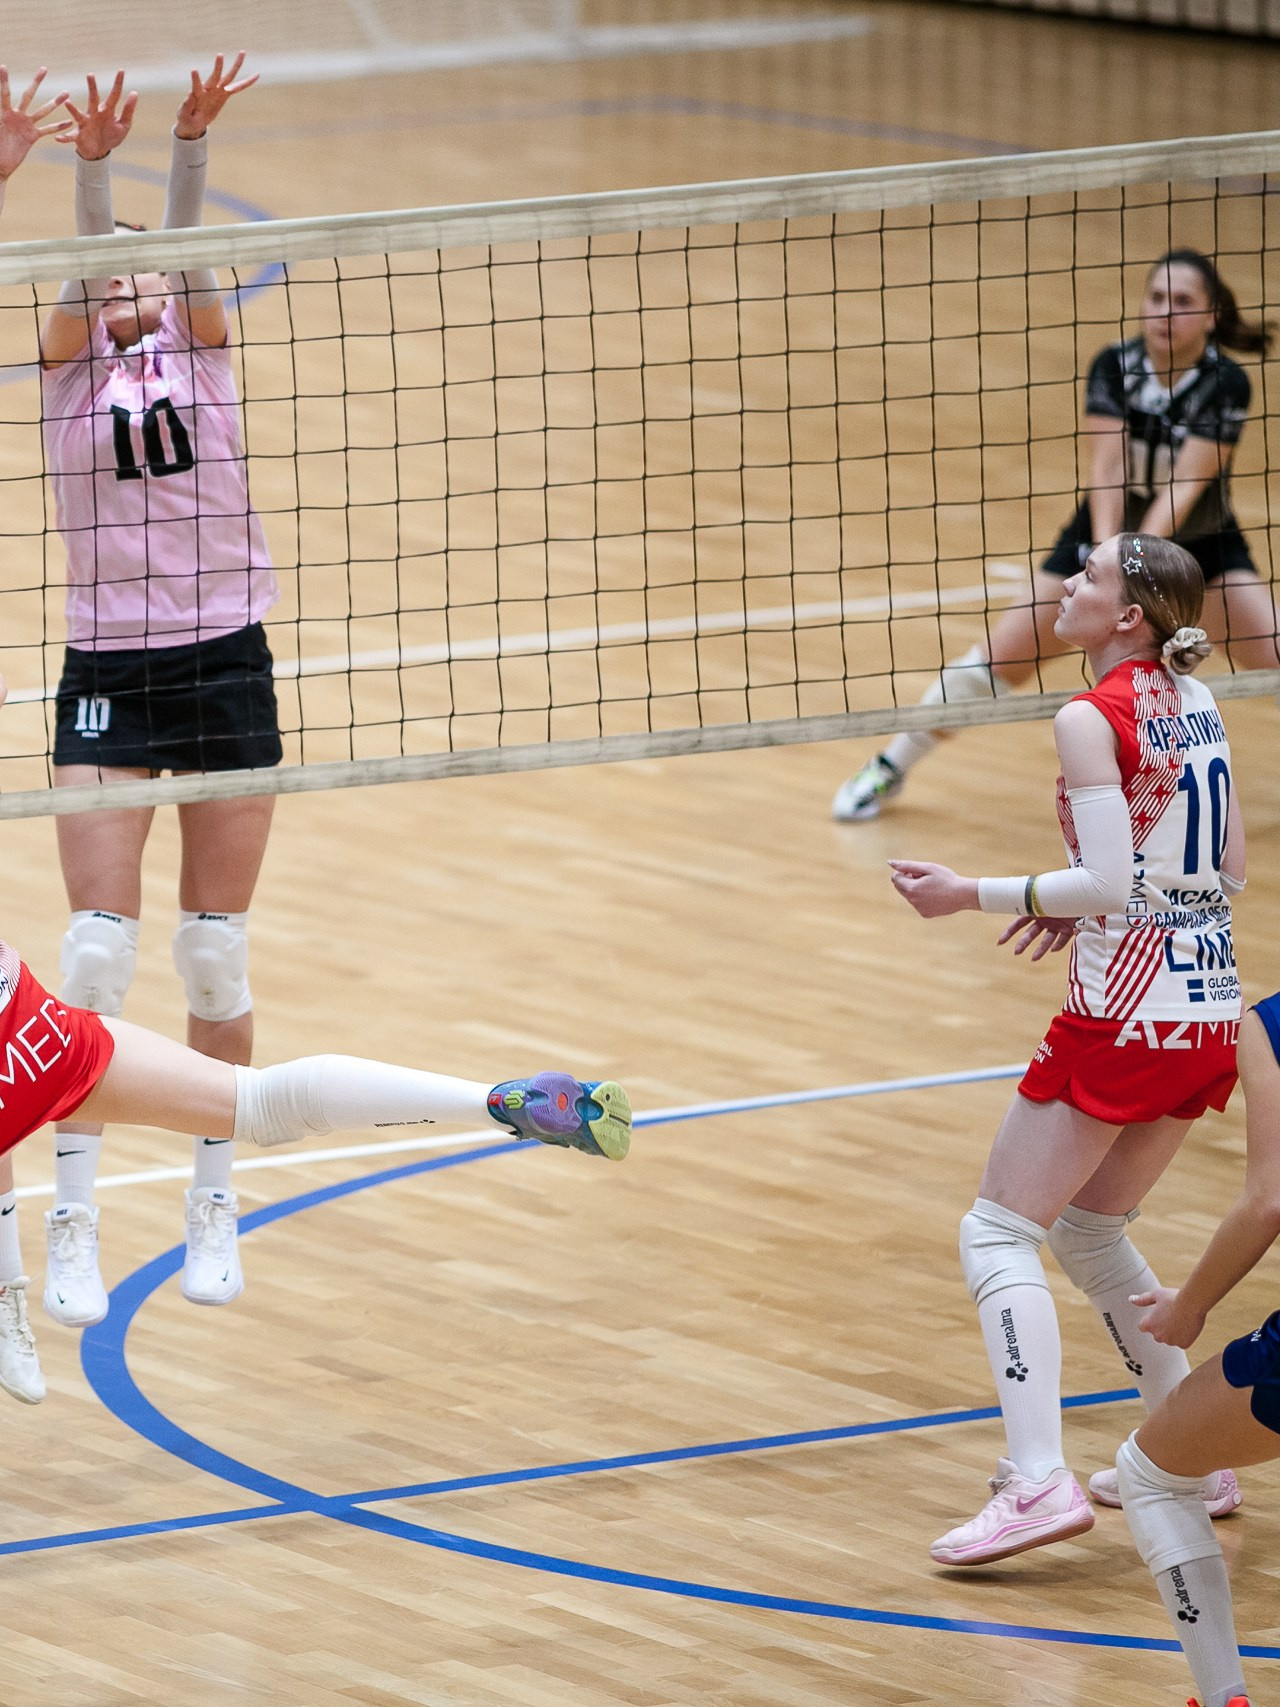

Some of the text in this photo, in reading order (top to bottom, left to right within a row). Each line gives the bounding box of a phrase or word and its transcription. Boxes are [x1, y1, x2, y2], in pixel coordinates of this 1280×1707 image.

[110, 396, 194, 481] 10
[74, 697, 110, 731] 10
[1178, 757, 1231, 875] 10
[1208, 976, 1240, 988] GLOBA
